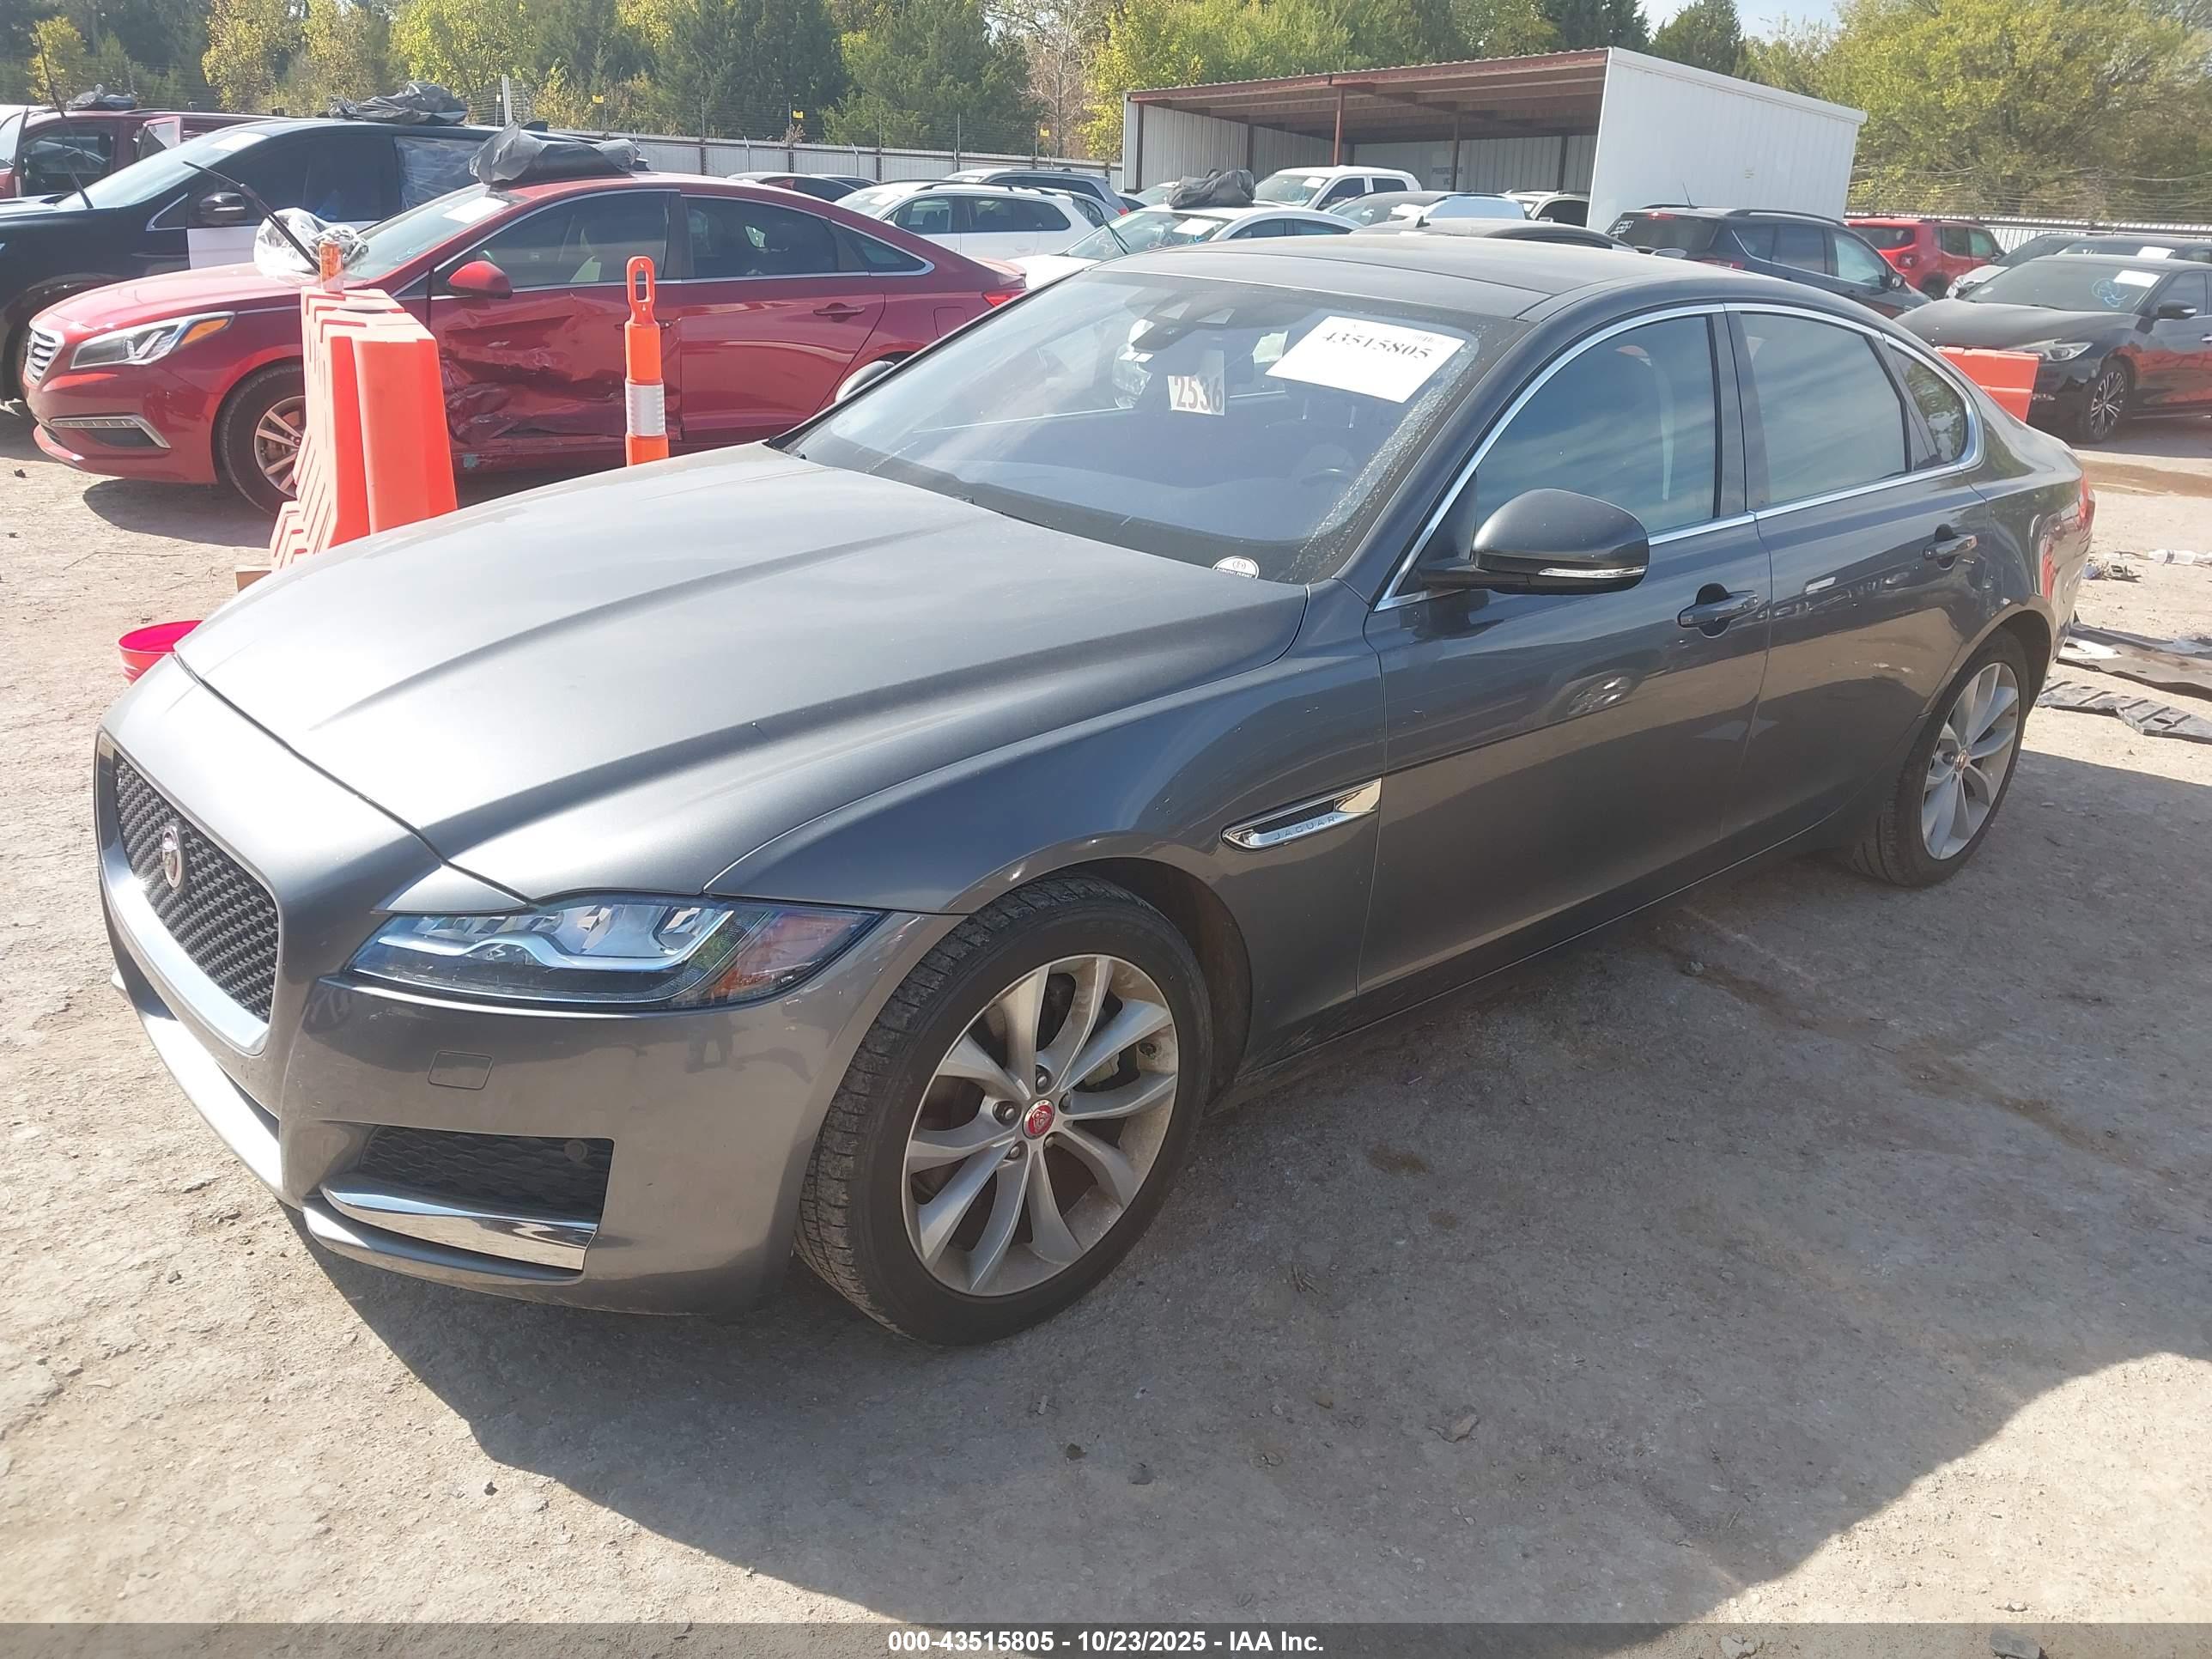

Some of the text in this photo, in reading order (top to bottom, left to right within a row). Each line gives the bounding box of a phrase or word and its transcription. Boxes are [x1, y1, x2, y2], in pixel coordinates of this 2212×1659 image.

[1322, 331, 1433, 359] 43515805
[1175, 376, 1224, 412] 2536
[1273, 816, 1335, 840] JAGUAR
